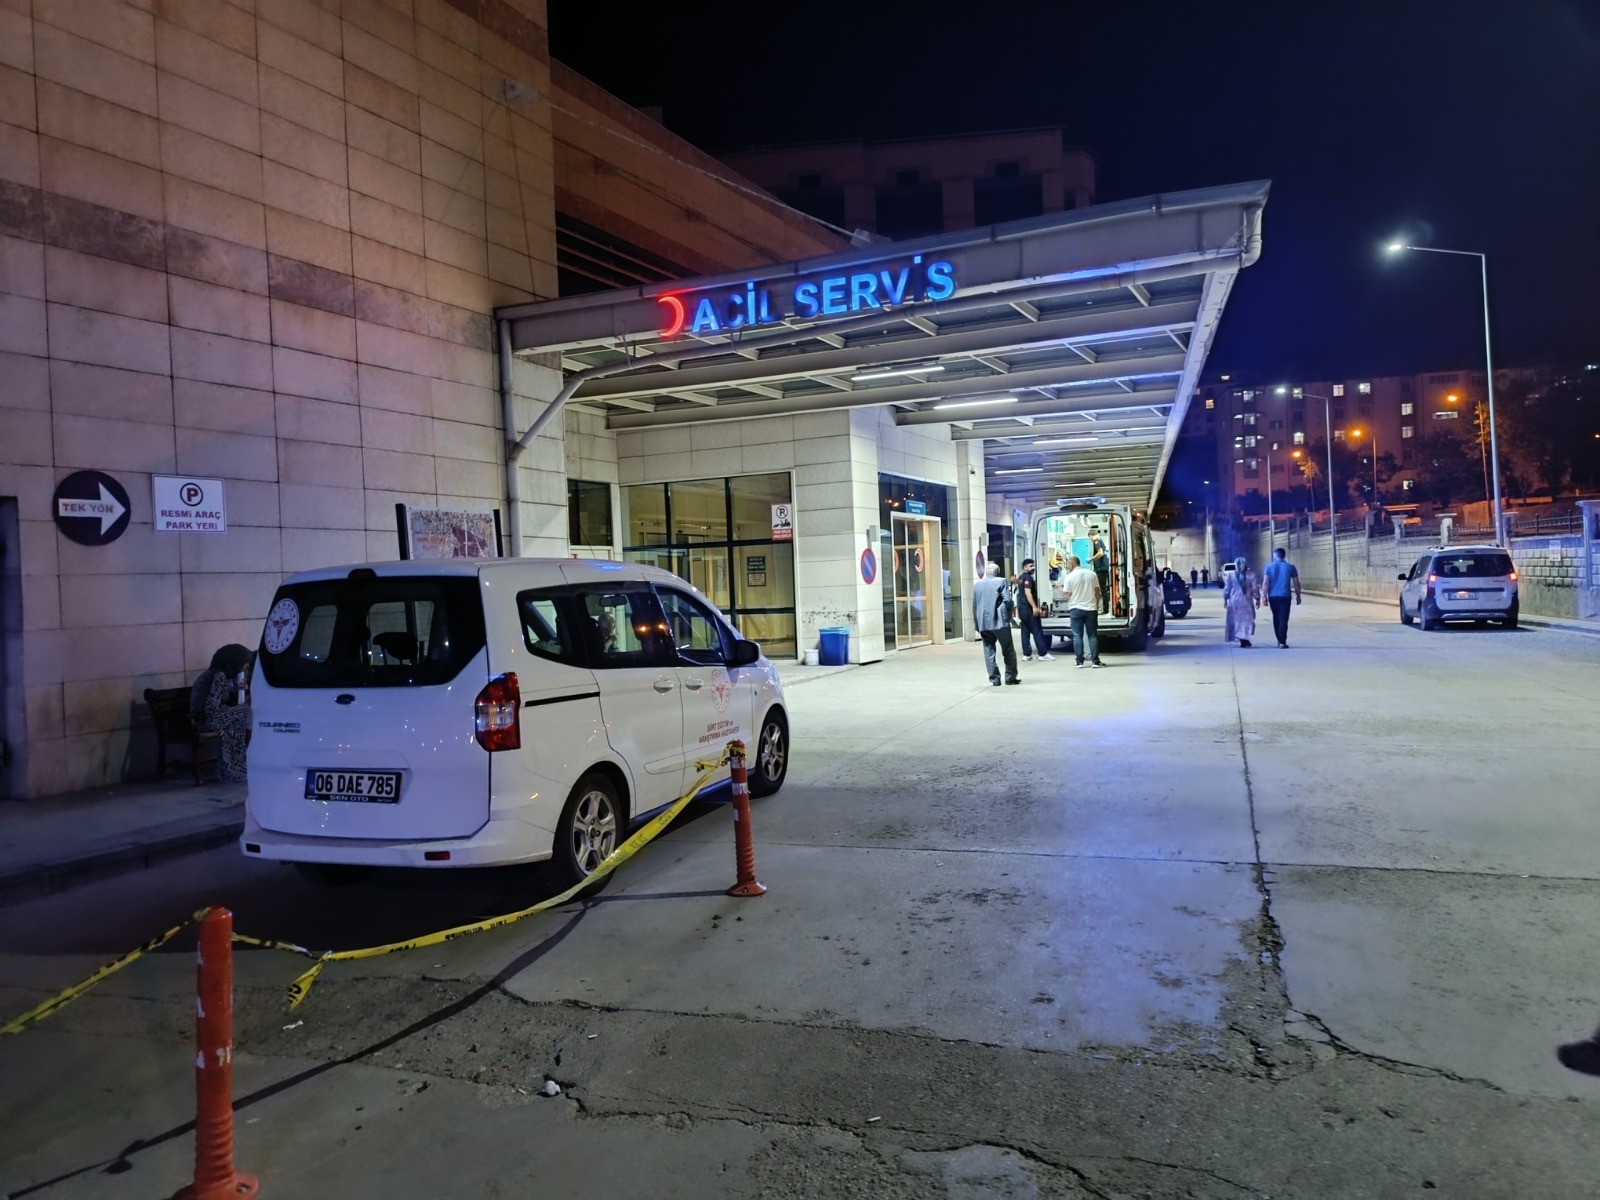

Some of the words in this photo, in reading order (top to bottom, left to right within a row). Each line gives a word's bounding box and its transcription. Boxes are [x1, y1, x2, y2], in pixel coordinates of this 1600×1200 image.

[692, 281, 777, 333] ACİL
[794, 255, 956, 318] SERVİS
[62, 503, 86, 512] TEK
[195, 510, 221, 520] ARAÇ
[165, 521, 193, 530] PARK
[315, 773, 333, 793] 06
[337, 774, 364, 794] DAE
[367, 775, 394, 796] 785
